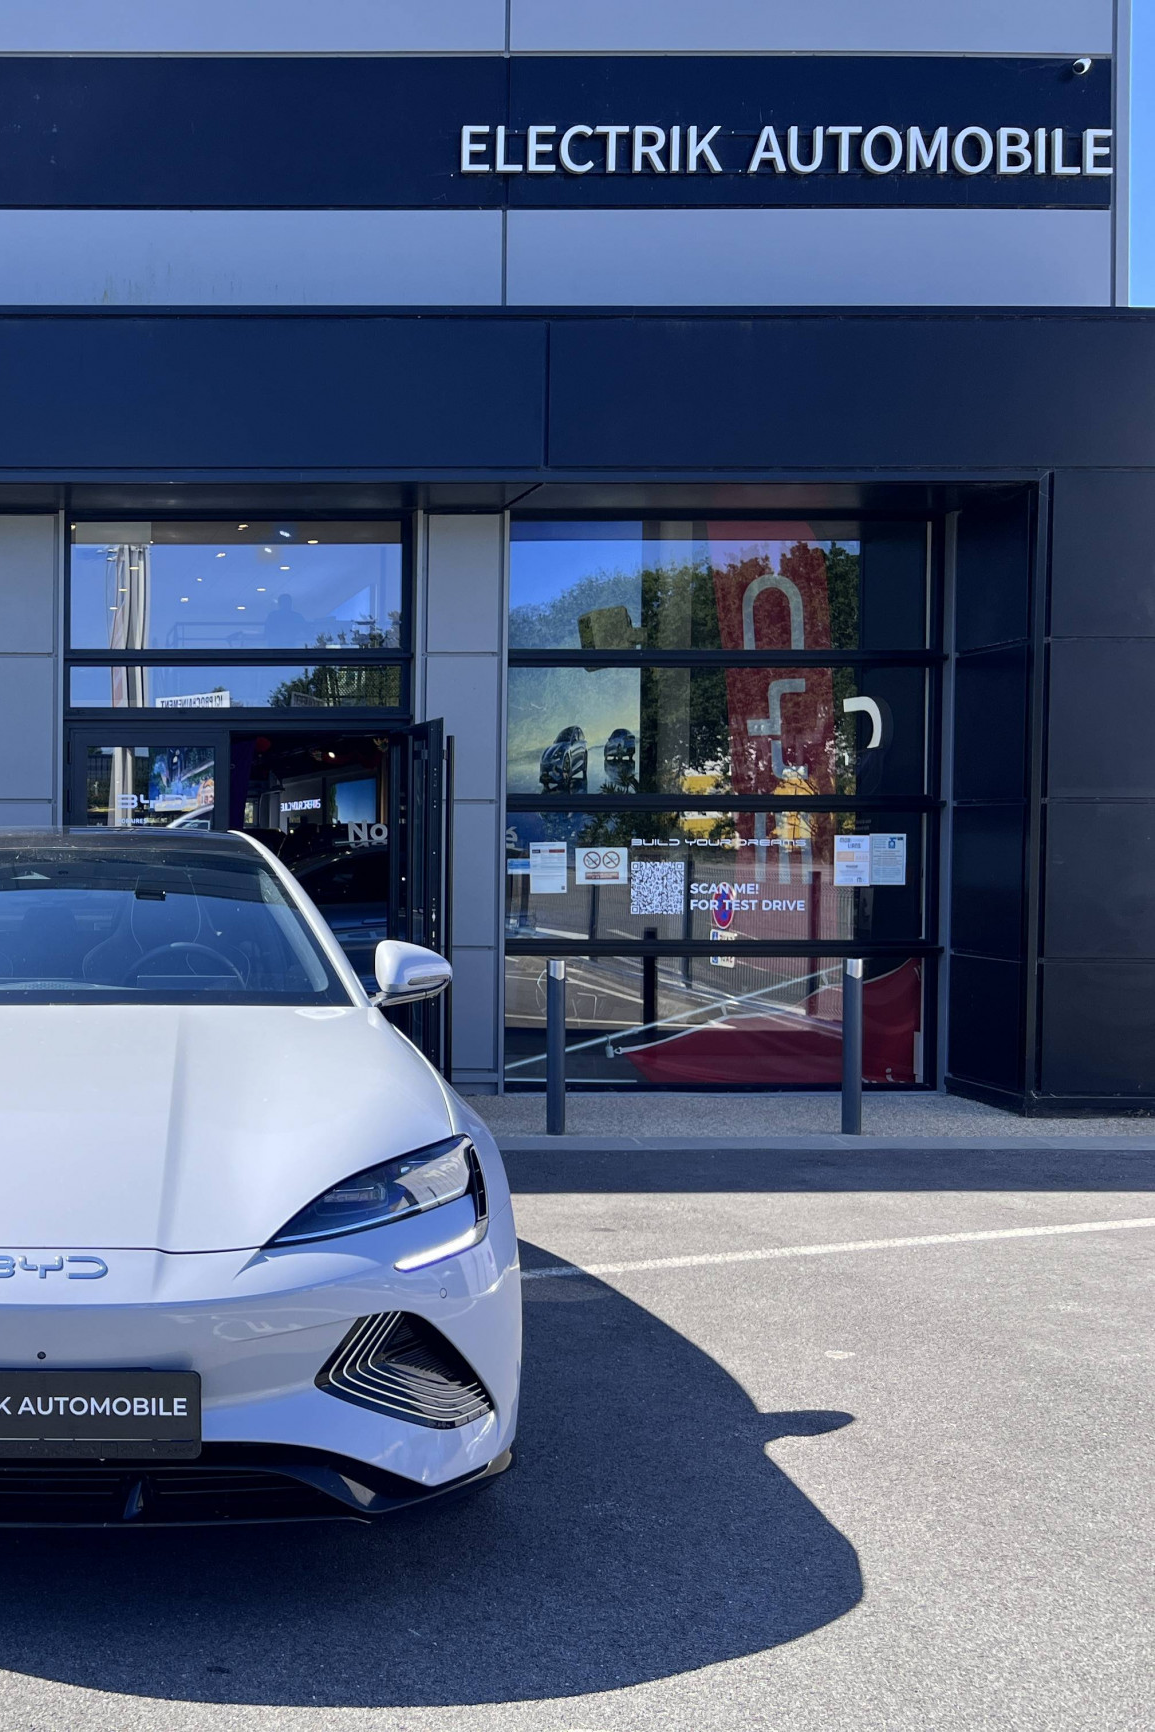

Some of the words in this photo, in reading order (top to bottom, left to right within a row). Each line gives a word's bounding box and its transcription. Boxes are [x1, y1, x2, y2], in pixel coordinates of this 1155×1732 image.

[460, 124, 723, 174] ELECTRIK
[747, 125, 1115, 176] AUTOMOBILE
[631, 838, 680, 847] BUILD
[684, 838, 732, 847] YOUR
[739, 838, 807, 847] DREAMS
[690, 883, 729, 895] SCAN
[734, 883, 759, 895] ME!
[690, 900, 719, 911] FOR
[723, 900, 757, 911] TEST
[762, 900, 805, 911] DRIVE
[17, 1396, 187, 1417] AUTOMOBILE
